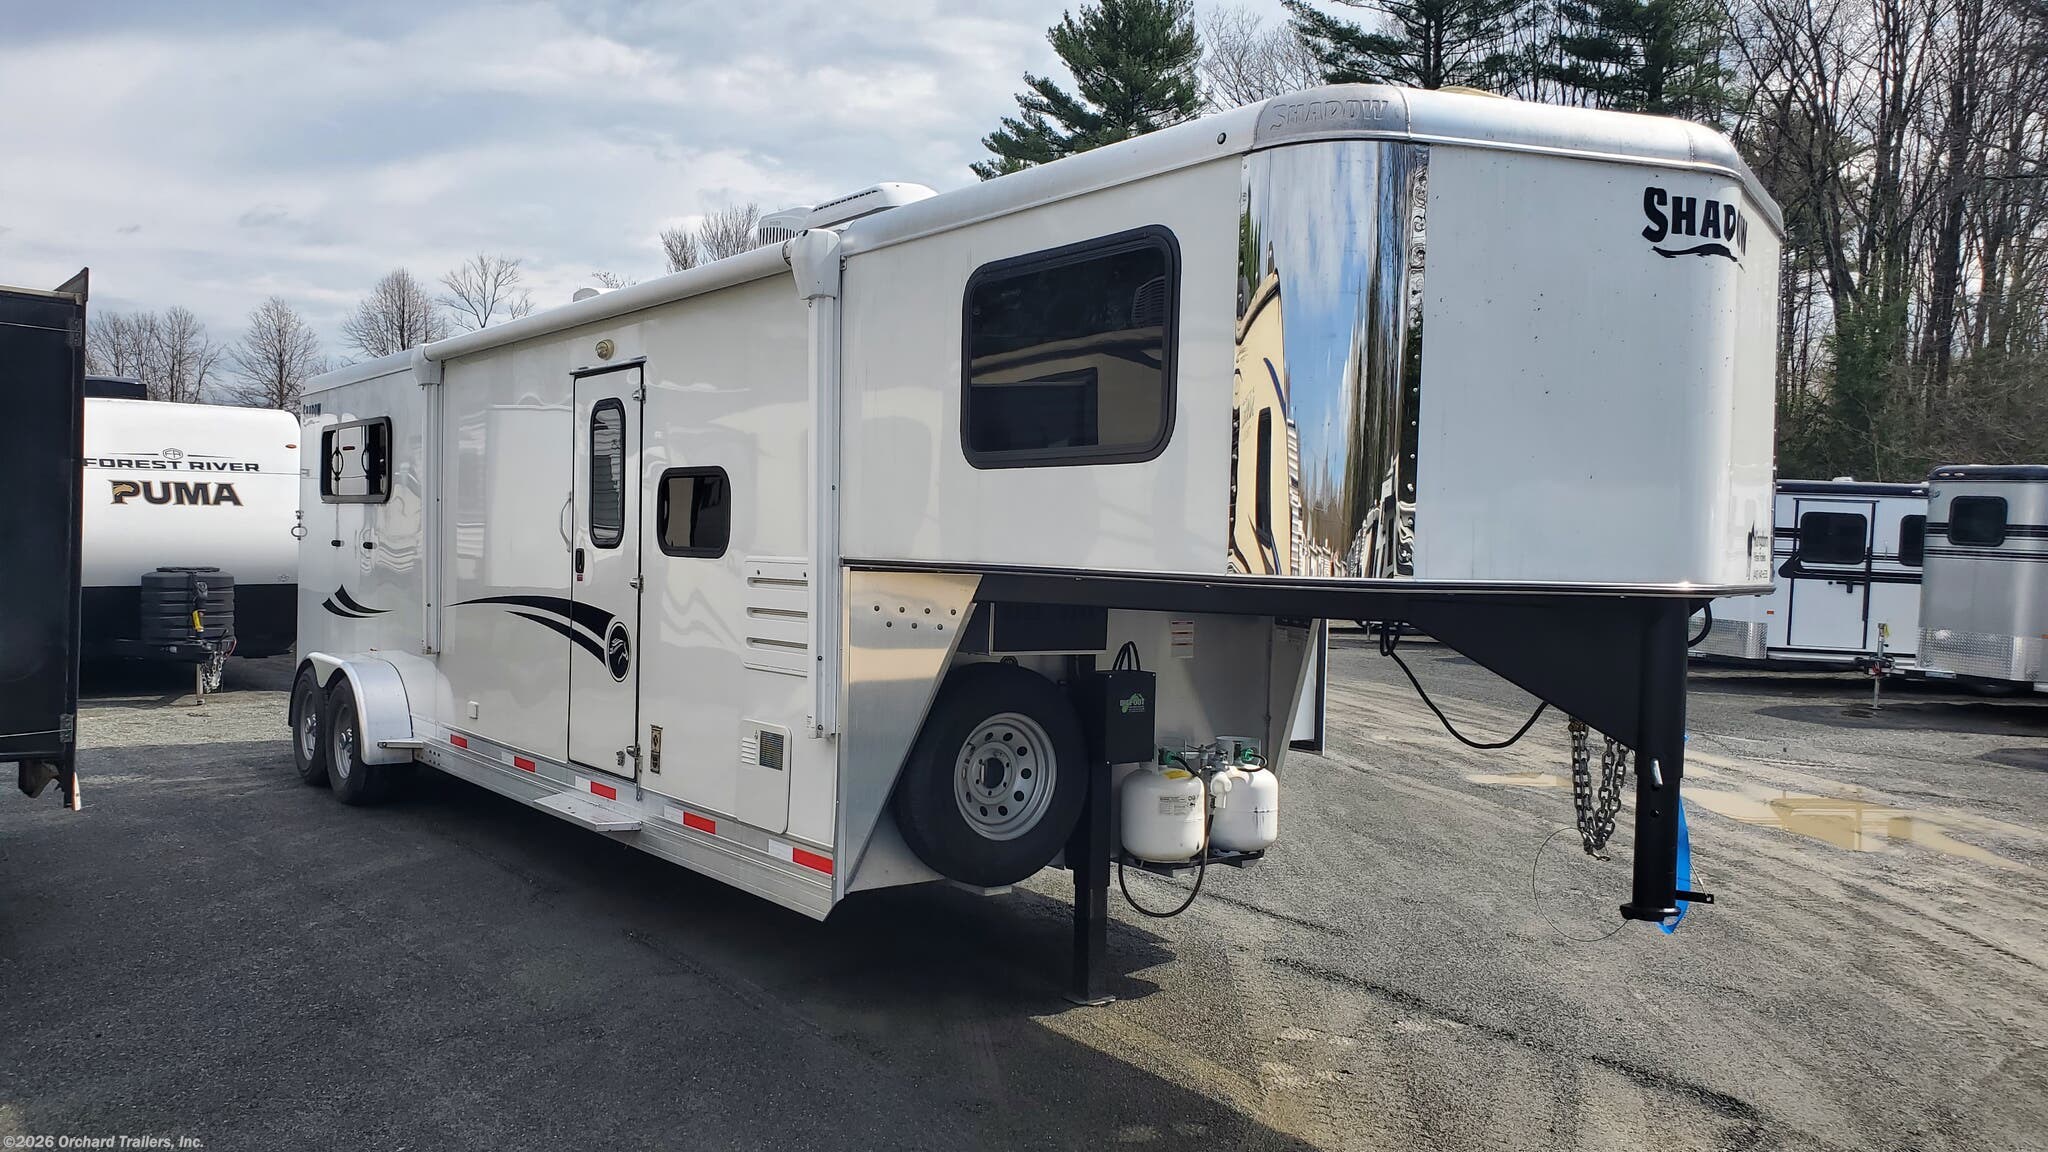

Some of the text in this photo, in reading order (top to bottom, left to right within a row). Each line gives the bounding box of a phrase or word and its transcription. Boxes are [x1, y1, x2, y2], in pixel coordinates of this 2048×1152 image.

[1270, 99, 1388, 131] SHADOW
[1642, 186, 1748, 257] SHADOW
[84, 457, 261, 472] FOREST RIVER
[108, 479, 244, 507] PUMA
